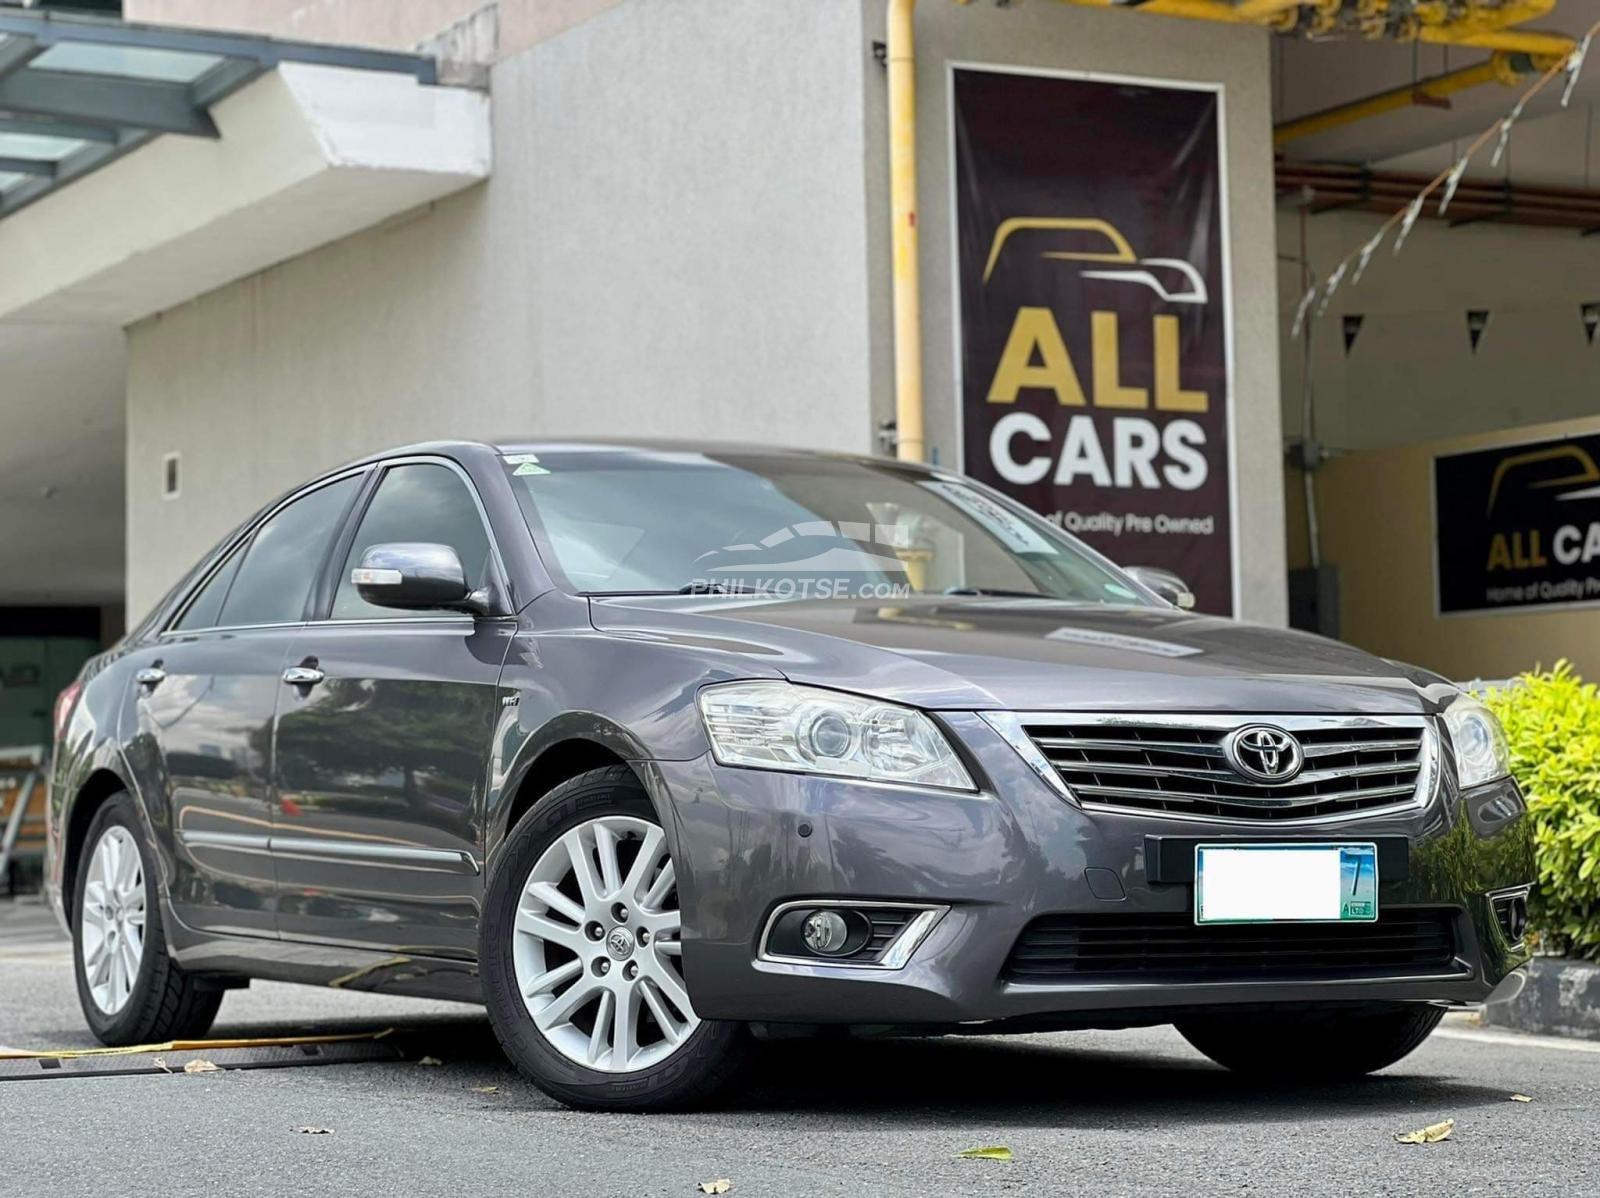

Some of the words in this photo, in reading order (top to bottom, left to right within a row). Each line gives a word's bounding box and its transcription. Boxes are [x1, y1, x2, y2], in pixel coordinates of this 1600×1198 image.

[987, 306, 1208, 412] ALL
[989, 412, 1208, 490] CARS
[1064, 511, 1124, 537] Quality
[1125, 513, 1152, 532] Pre
[1154, 514, 1214, 535] Owned
[1486, 529, 1547, 571] ALL
